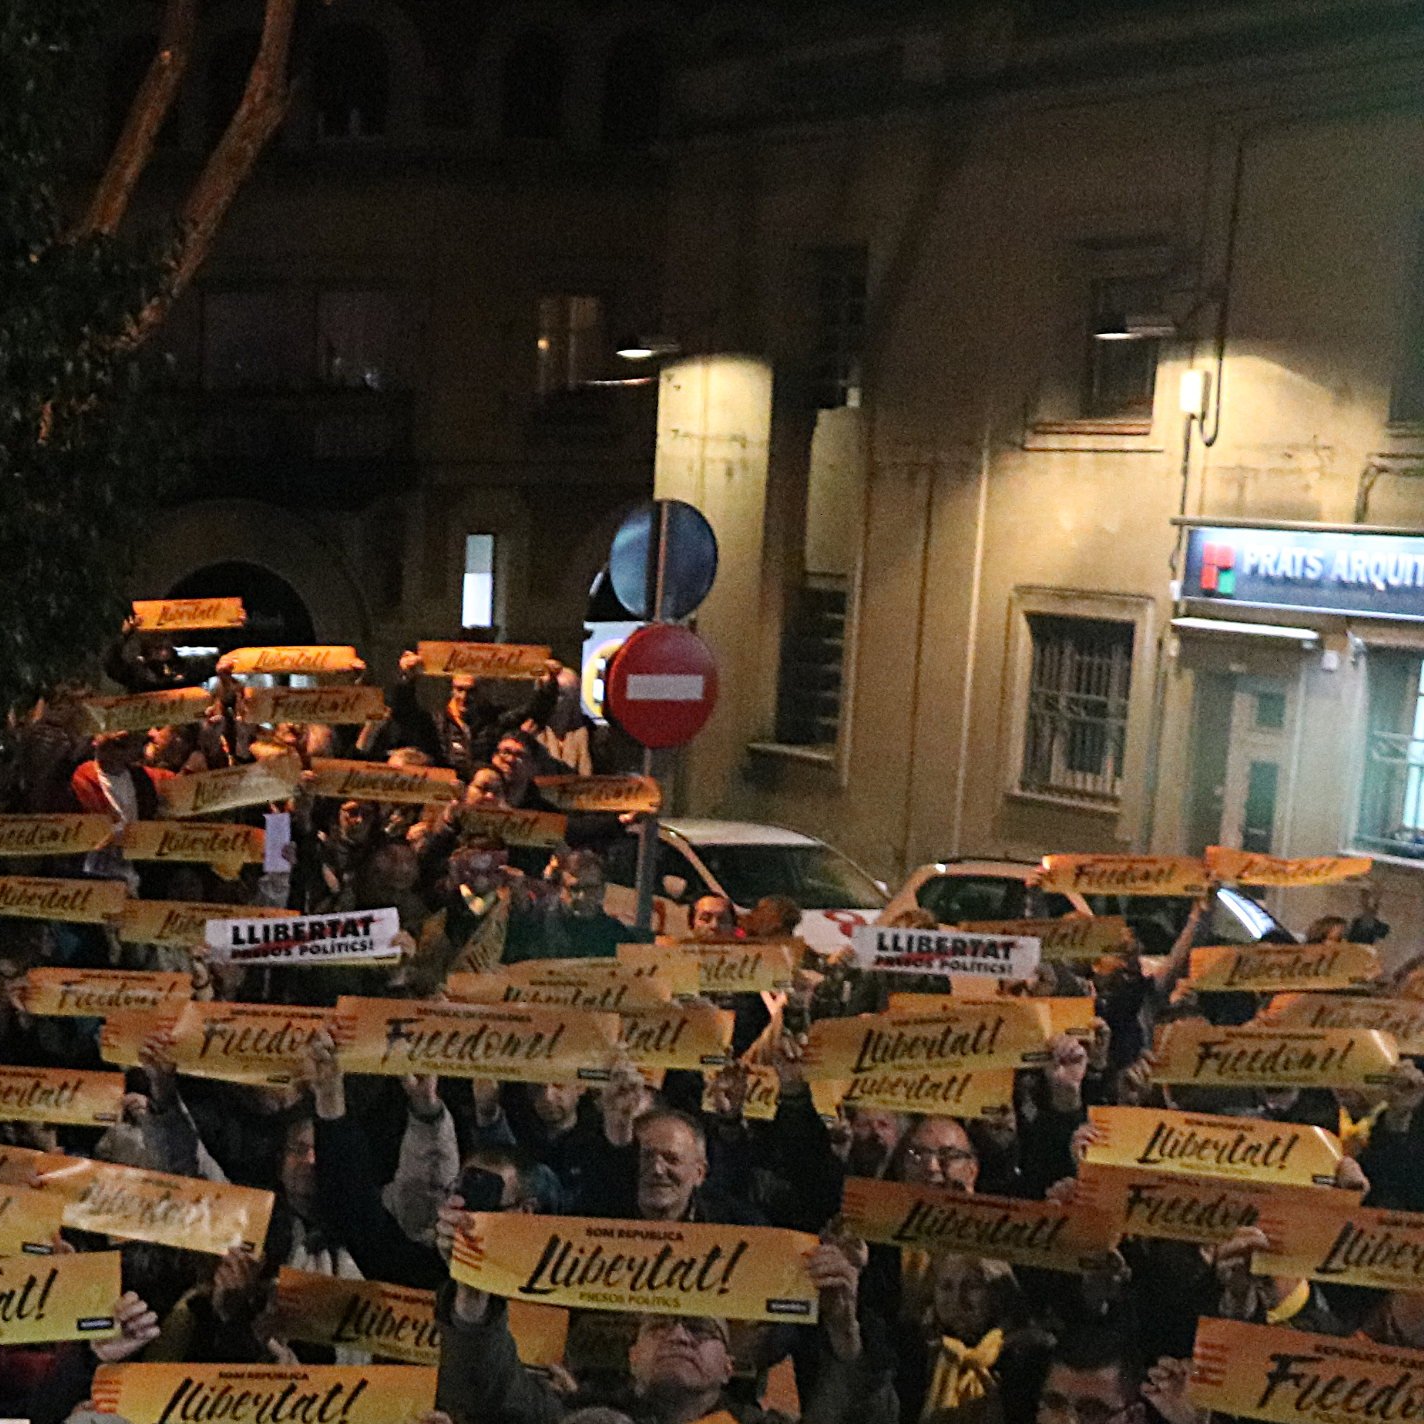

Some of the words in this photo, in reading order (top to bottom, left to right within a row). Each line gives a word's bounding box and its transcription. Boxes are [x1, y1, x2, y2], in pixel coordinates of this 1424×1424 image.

[1243, 546, 1324, 580] PRATS
[230, 914, 375, 946] LLIBERTAT
[875, 932, 1016, 959] LLIBERTAT
[386, 1015, 561, 1061] Freedom!
[855, 1020, 1004, 1072] Llibertat!
[1194, 1039, 1355, 1076] Freedom!
[1138, 1120, 1299, 1170] Llibertat!
[585, 1227, 620, 1240] SOM
[894, 1201, 1073, 1250] Llibertat!
[521, 1234, 749, 1295] Llibertat!
